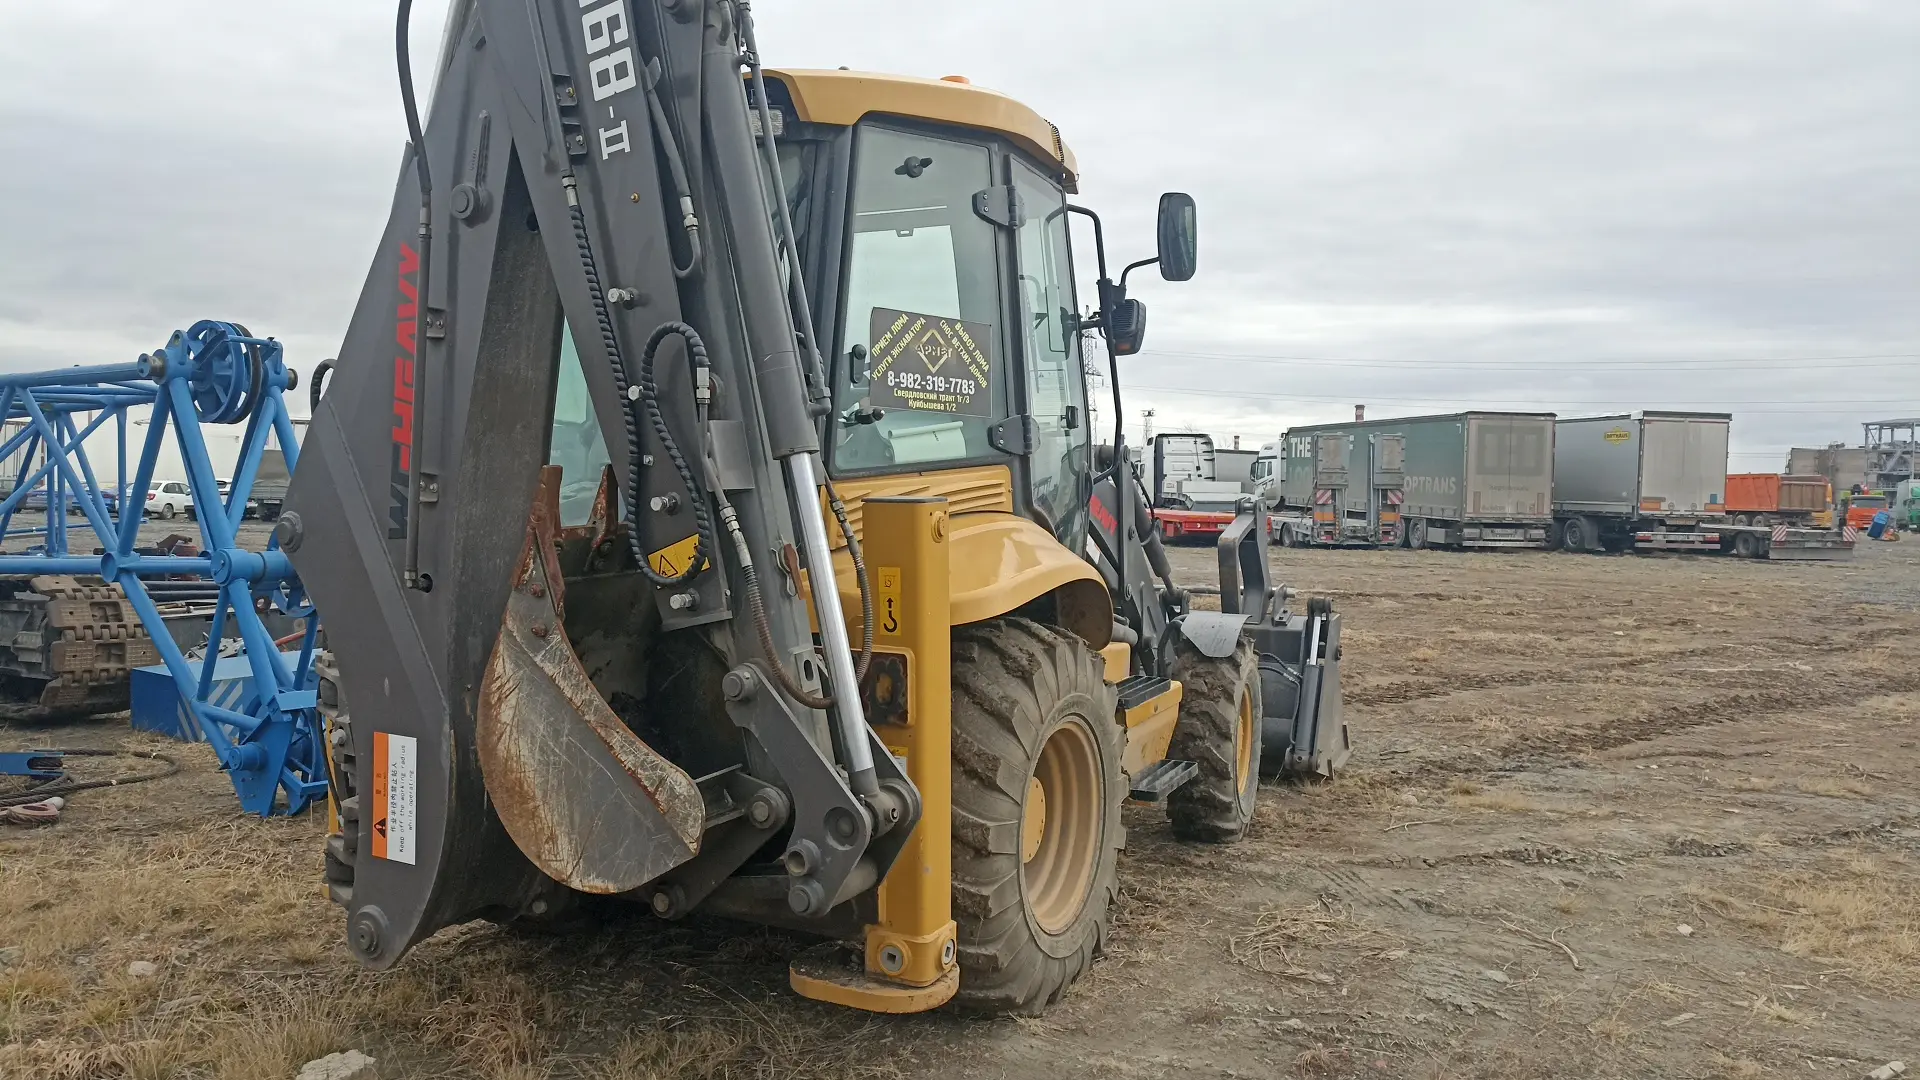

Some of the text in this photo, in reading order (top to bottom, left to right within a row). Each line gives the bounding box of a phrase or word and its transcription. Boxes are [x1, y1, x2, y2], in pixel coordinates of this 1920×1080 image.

[872, 313, 910, 357] ПРИЕМ ЛОМА
[872, 317, 926, 381] УСЛУГИ ЭКСКАВАТОРА
[954, 322, 990, 373] ВЫВОЗ ЛОМА
[939, 319, 988, 388] СНОС ВЕТХИХ ДОМОВ
[887, 371, 975, 395] 8-982-319-7783
[894, 388, 937, 400] Свердловский
[939, 393, 955, 402] тракт
[908, 399, 957, 412] Куйбышева 1/2
[1290, 436, 1312, 458] THE
[399, 772, 407, 801] working
